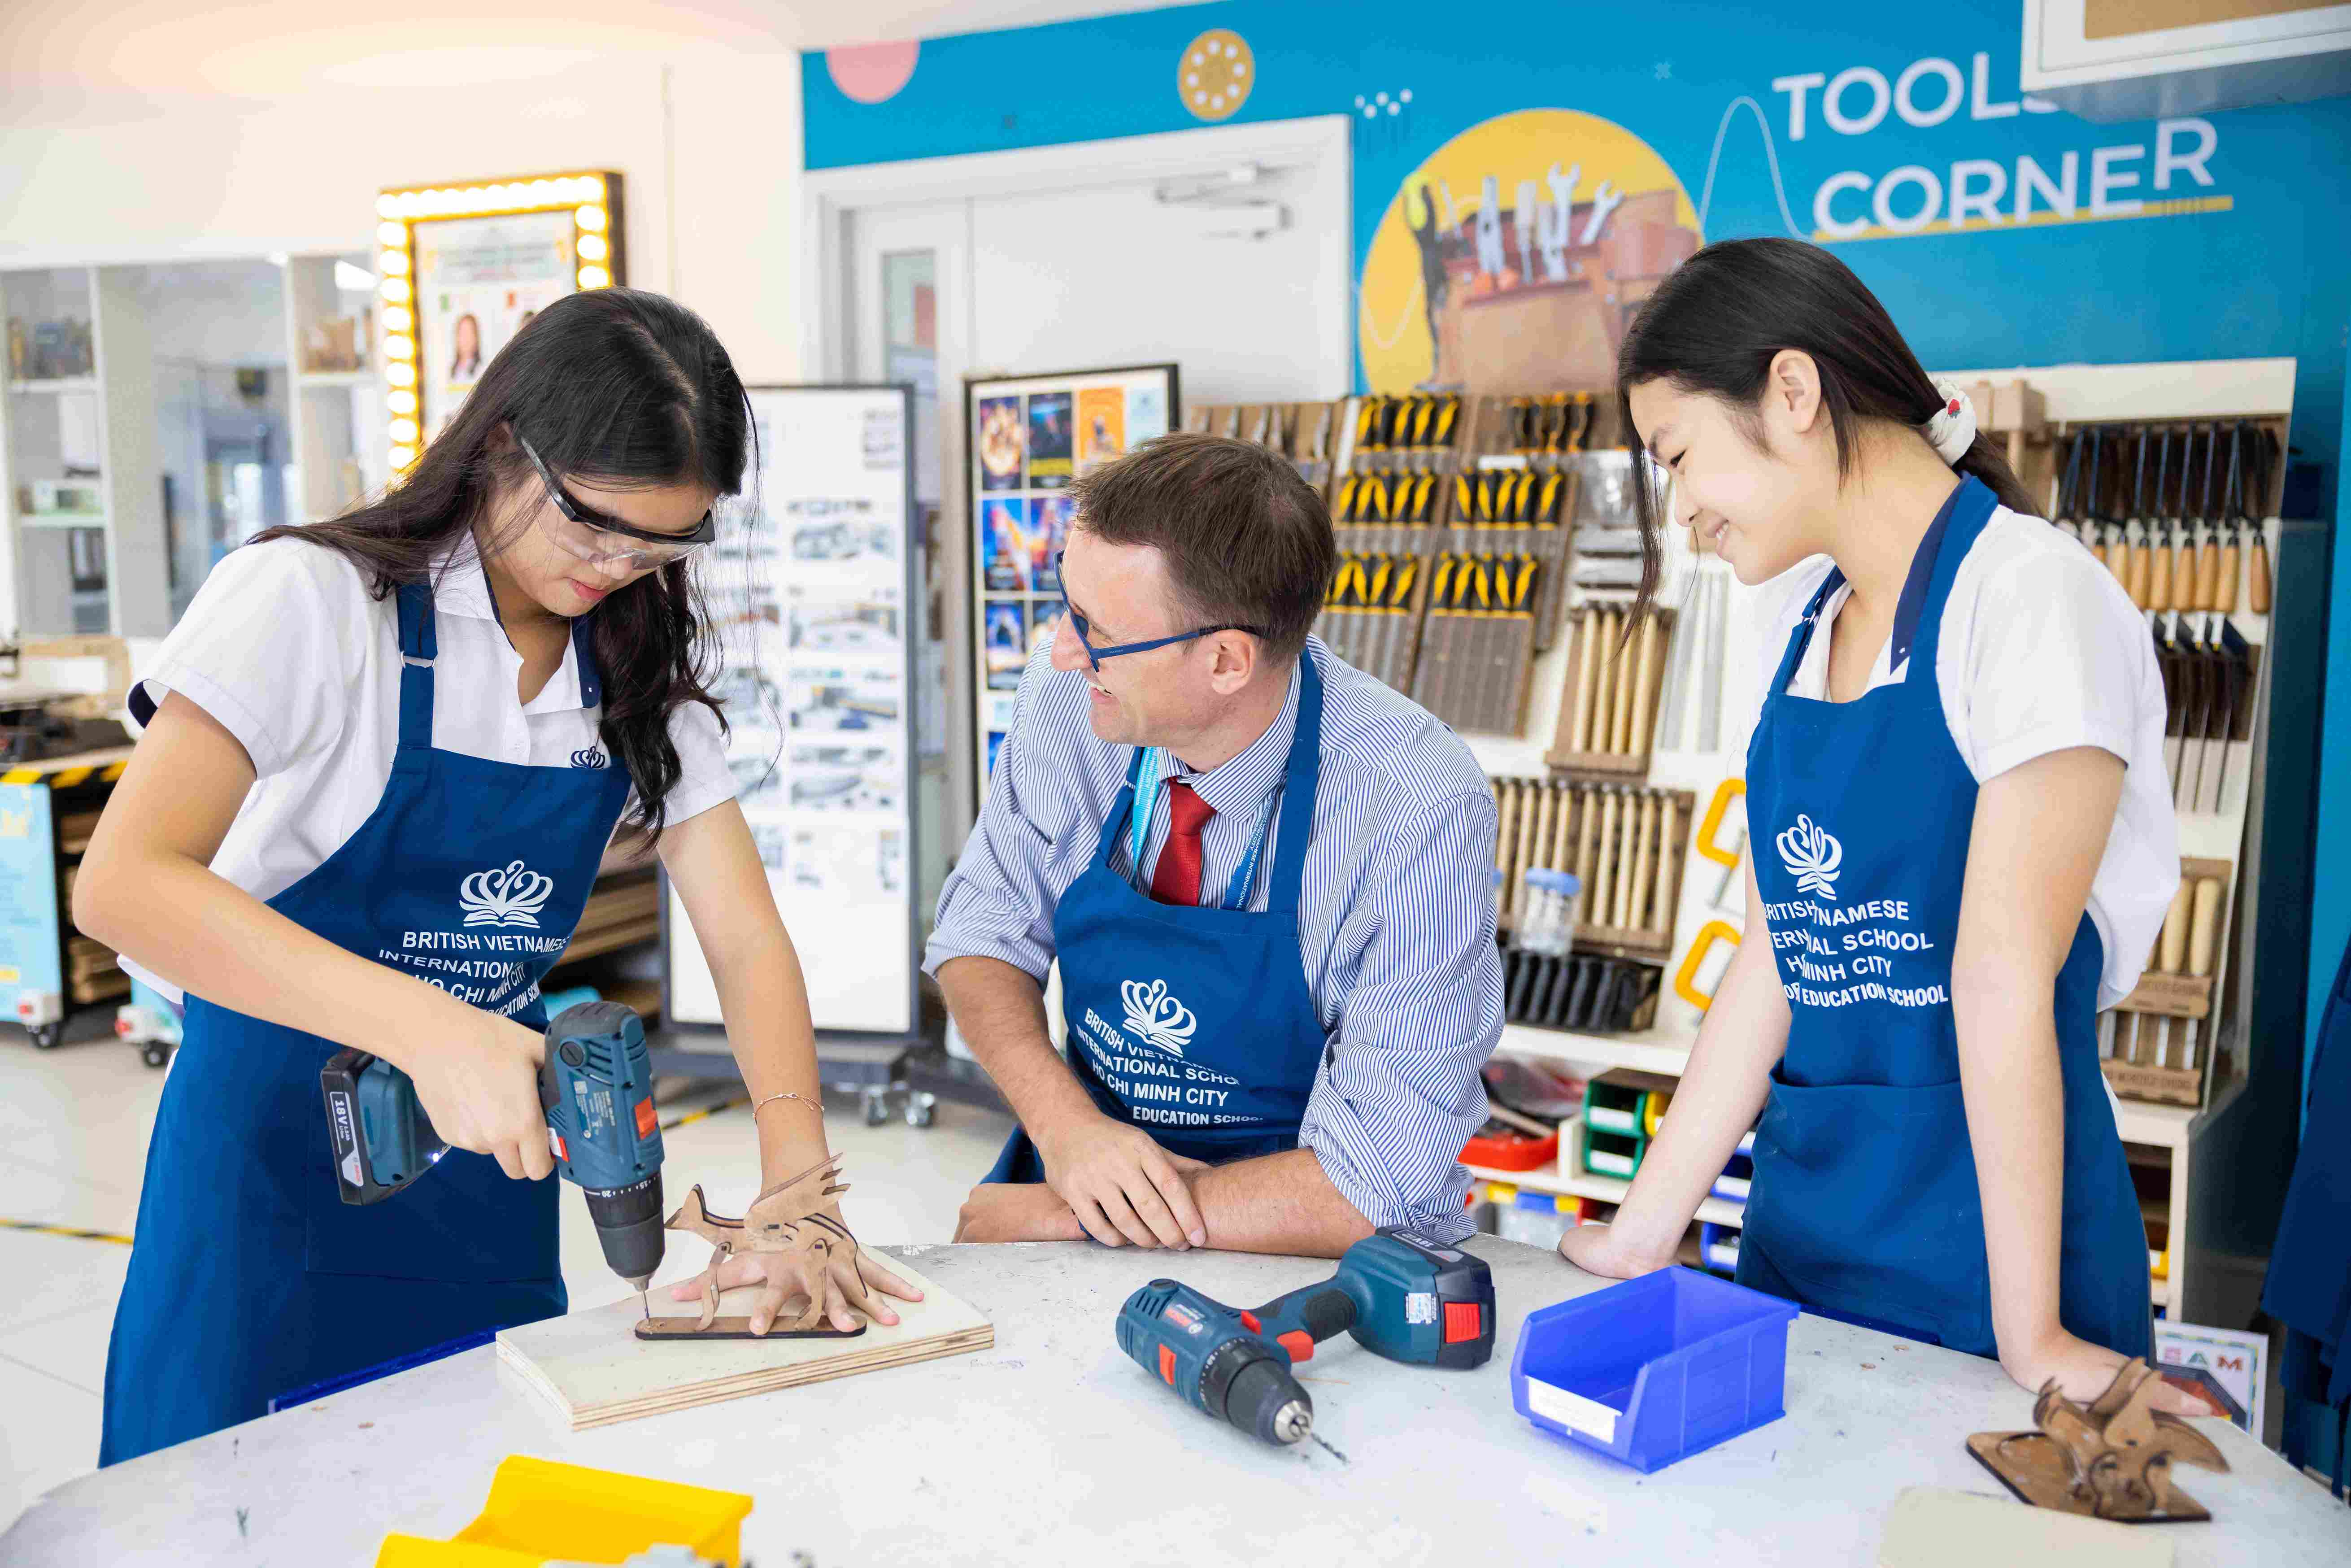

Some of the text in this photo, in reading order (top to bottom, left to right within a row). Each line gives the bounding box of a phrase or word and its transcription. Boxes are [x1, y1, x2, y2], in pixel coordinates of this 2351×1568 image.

[1772, 52, 2059, 141] TOOL
[1813, 118, 2218, 236] CORNER
[1236, 862, 1253, 909] INTERNATIONAL
[403, 931, 570, 953] BRITISH VIETNAMES
[1842, 928, 1934, 951] SCHOOL
[379, 949, 514, 979] INTERNATION
[1802, 962, 1846, 982] MINH
[1852, 956, 1892, 977] CITY
[450, 984, 484, 1003] CHI
[511, 964, 526, 987] CITY
[1802, 982, 1887, 1007] EDUCATION
[1887, 984, 1949, 1007] SCHOOL
[1084, 1008, 1124, 1052] BRITISH
[1076, 1024, 1180, 1079] INTERNATIONAL
[1093, 1058, 1229, 1106] HO CHI MINH CITY
[335, 1100, 348, 1125] 18V
[1133, 1106, 1209, 1125] EDUCATION
